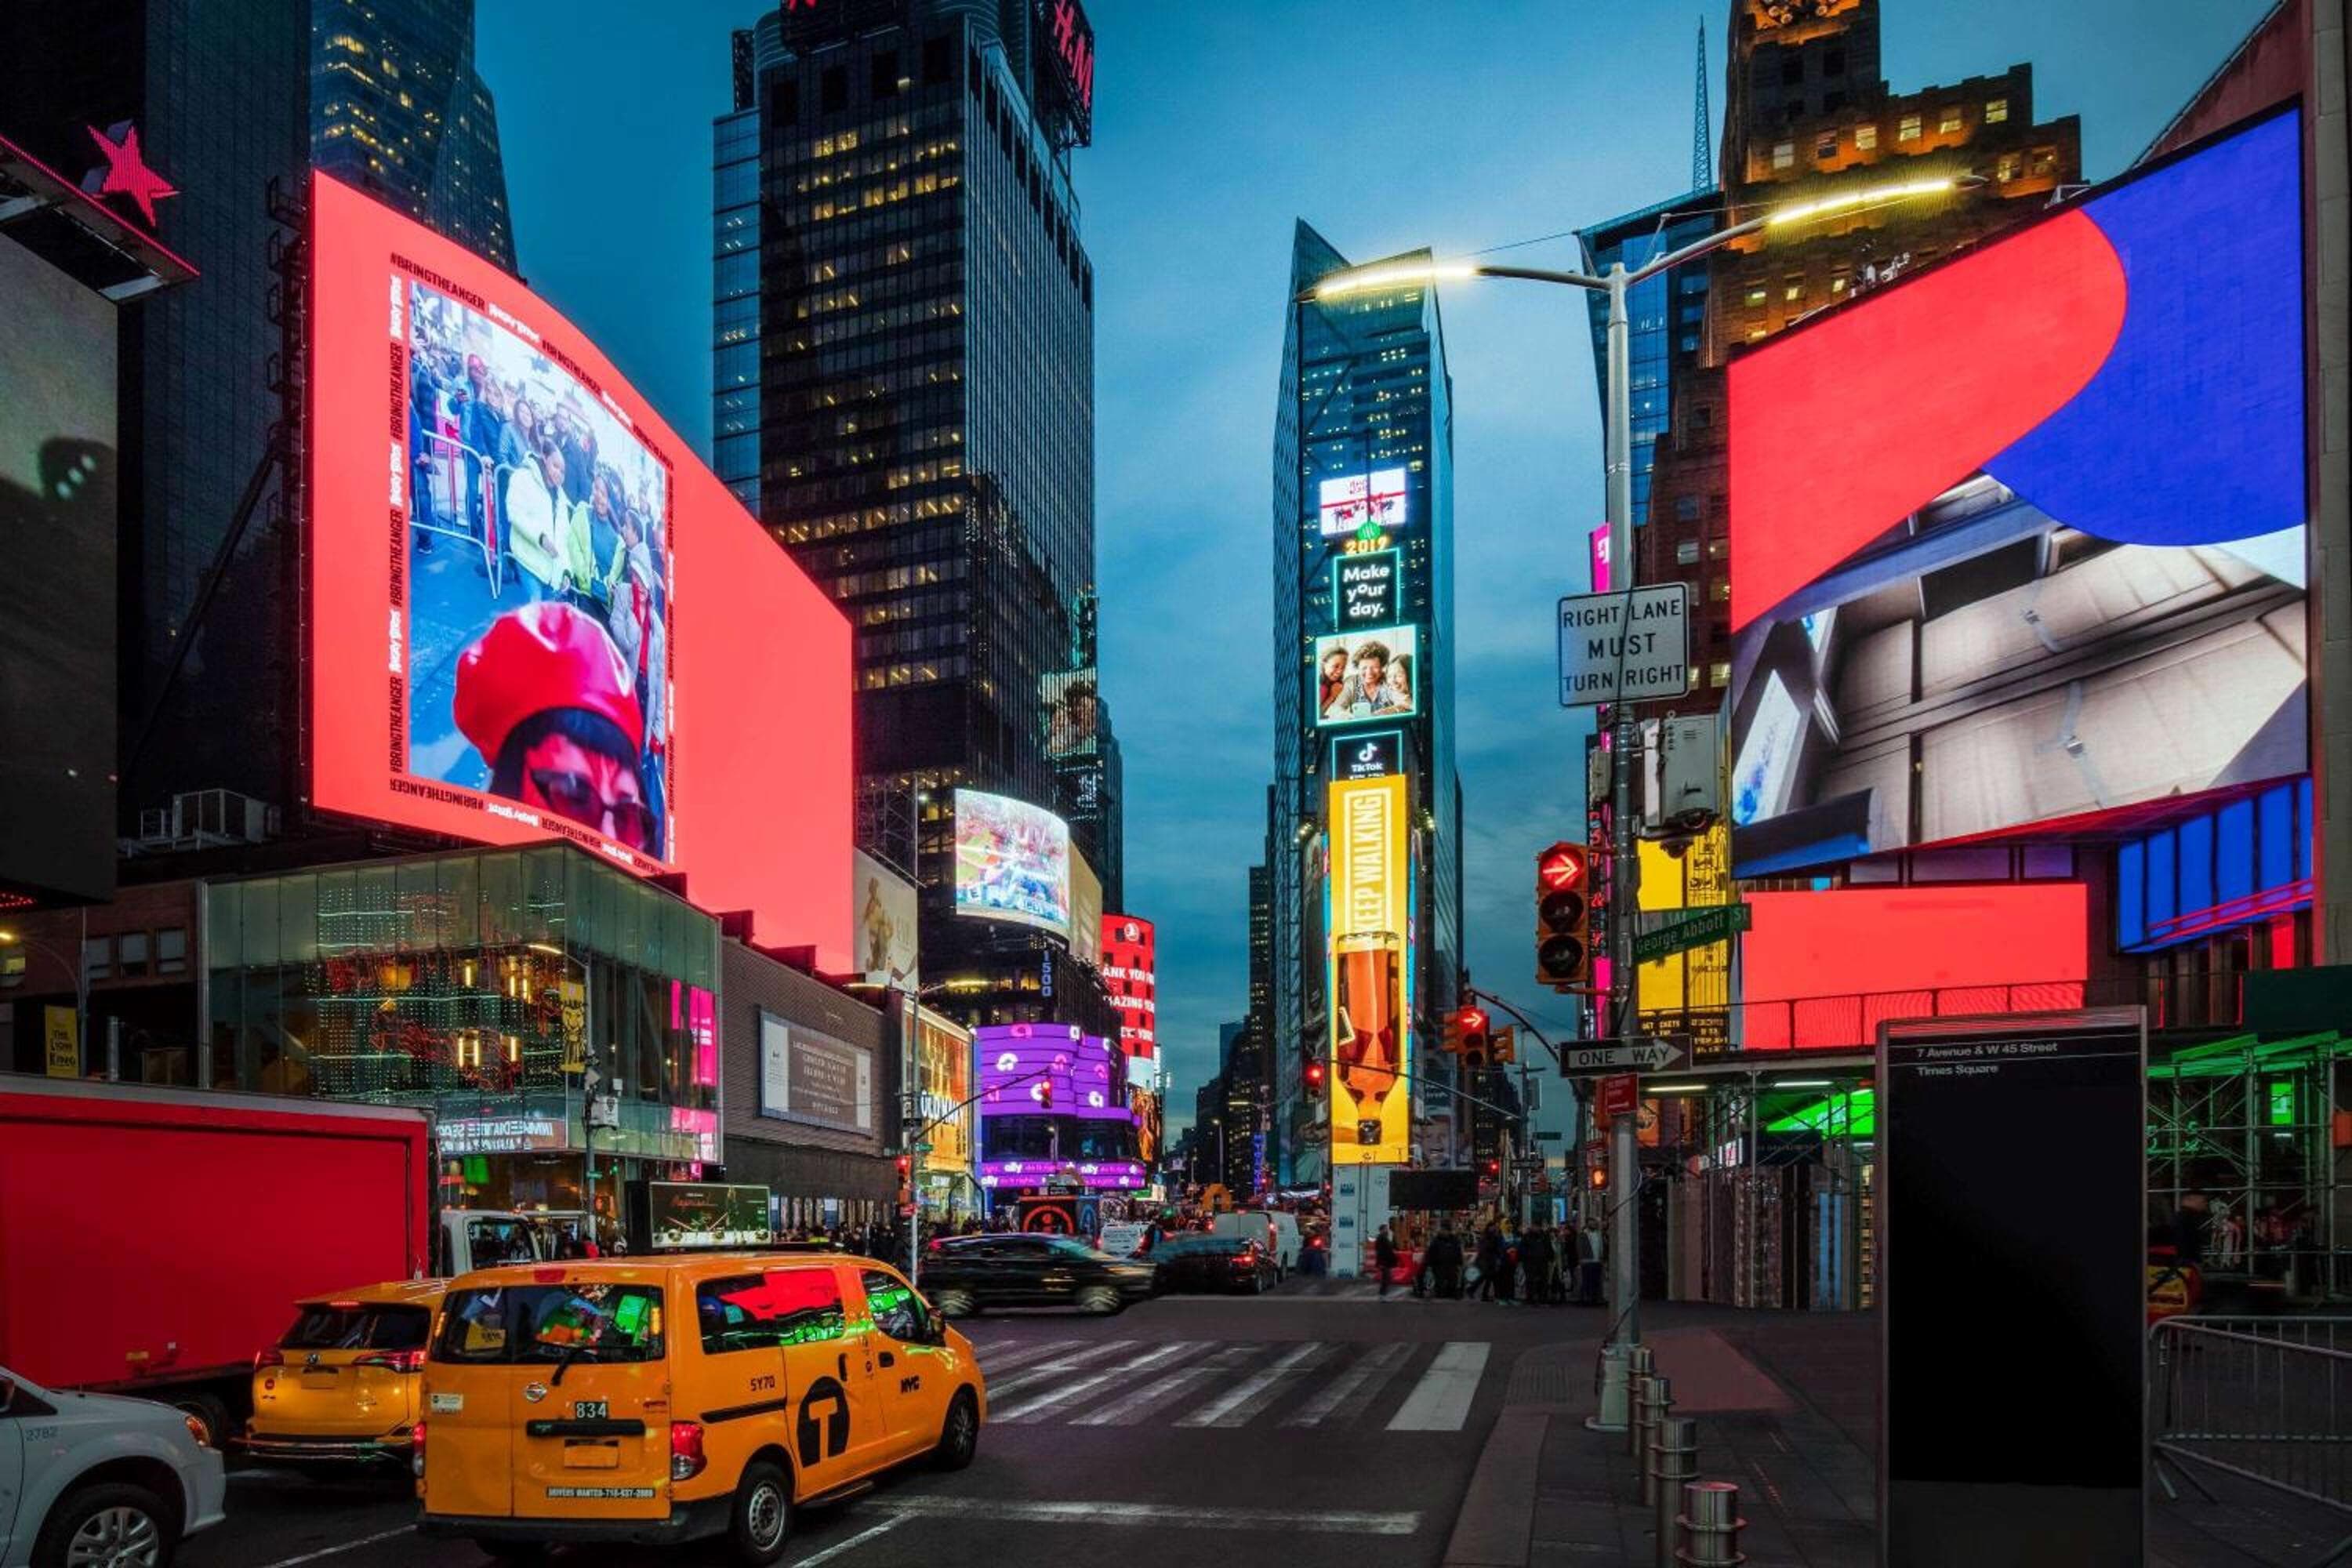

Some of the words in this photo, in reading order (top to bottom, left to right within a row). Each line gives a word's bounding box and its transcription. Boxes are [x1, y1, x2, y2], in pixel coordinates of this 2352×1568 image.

[1054, 0, 1092, 110] H&M
[390, 252, 485, 310] #BRINGTHEANGER
[390, 343, 404, 441] #BRINGTHEANGER
[390, 510, 404, 607] #BRINGTHEANGER
[1343, 564, 1389, 582] Make
[1347, 584, 1385, 601] your
[1349, 601, 1384, 618] day.
[1563, 606, 1620, 628] RIGHT
[1632, 599, 1681, 620] LANE
[1588, 633, 1656, 659] MUST
[1563, 672, 1613, 692] TURN
[1625, 664, 1683, 687] RIGHT
[390, 676, 404, 774] #BRINGTHEANGER
[1351, 762, 1384, 773] TikTok
[390, 779, 483, 810] #BRINGTHEANGER
[1354, 794, 1382, 882] WALKING
[1354, 886, 1382, 931] KEEP
[1578, 1050, 1615, 1065] ONE
[1632, 1046, 1669, 1062] WAY
[1918, 1048, 1922, 1057] 7
[1927, 1048, 1972, 1058] Avenue
[1975, 1046, 1983, 1055] &
[1986, 1045, 1999, 1054] W
[2002, 1044, 2017, 1054] 45
[2020, 1042, 2058, 1053] Street
[1918, 1066, 1952, 1076] Times
[1955, 1064, 1998, 1076] Square
[900, 1375, 920, 1394] NYC
[576, 1403, 607, 1418] 834
